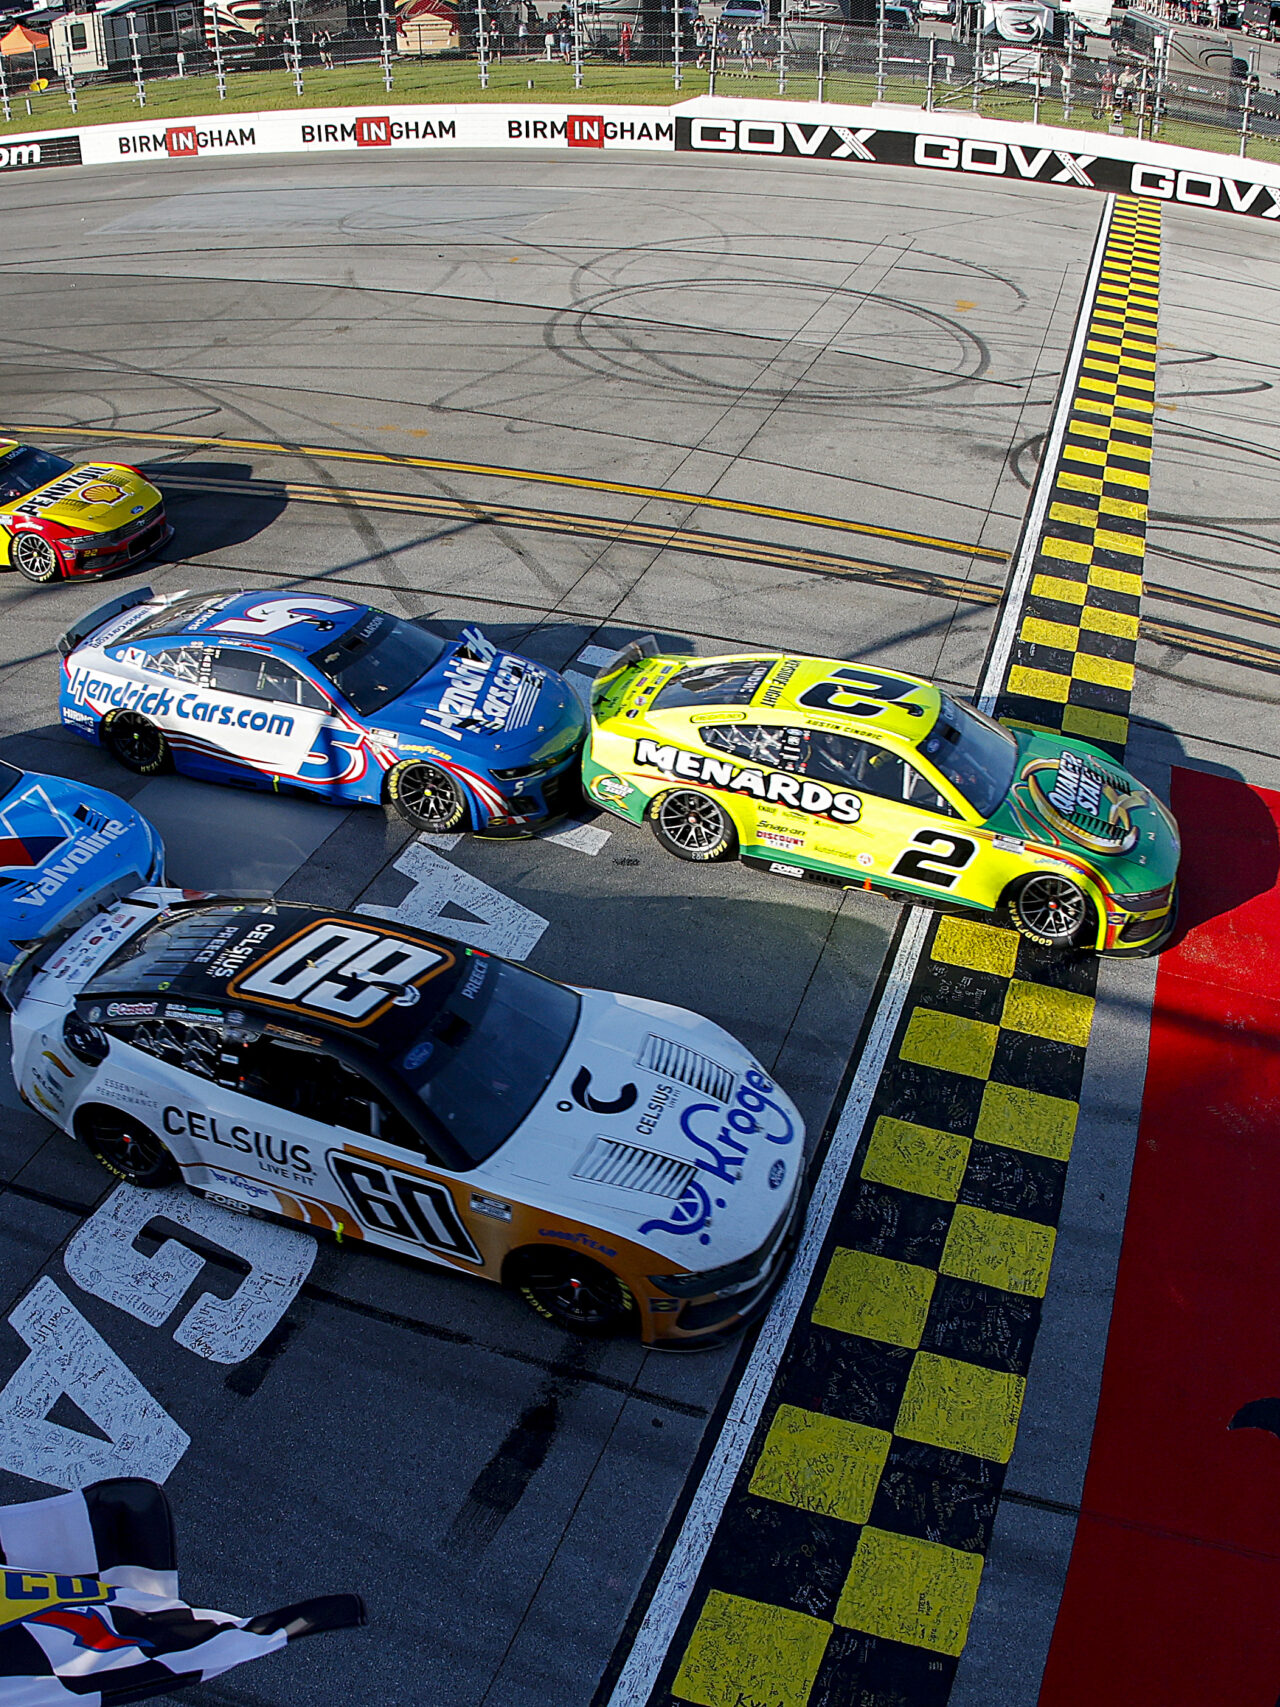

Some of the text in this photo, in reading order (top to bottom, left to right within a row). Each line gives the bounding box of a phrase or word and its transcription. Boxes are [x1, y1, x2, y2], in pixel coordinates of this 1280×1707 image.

[119, 125, 256, 157] BIRMINGHAM
[302, 116, 457, 147] BIRMINGHAM
[507, 114, 675, 149] BIRMINGHAM
[690, 118, 877, 162] GOVX
[914, 134, 1096, 187] GOVX
[13, 466, 117, 517] PENNZOIL
[360, 615, 385, 639] LARSON
[420, 624, 499, 740] Hendrick
[63, 708, 94, 728] HIRING
[806, 719, 883, 740] AUSTIN CINDRIC
[297, 725, 366, 782] 5
[634, 739, 862, 824] MENARDS
[1046, 750, 1084, 815] QUAKER
[1075, 763, 1106, 817] STATE
[756, 830, 805, 847] DISCOUNT
[757, 820, 806, 836] Snap-on
[12, 818, 130, 908] Valvoline
[771, 862, 804, 877] FORD
[890, 826, 977, 889] 2
[193, 926, 241, 964] PREECE
[215, 922, 275, 979] CELSIUS
[462, 960, 489, 1000] PREECE
[264, 1023, 324, 1046] PREECE
[96, 1086, 160, 1109] PERFORMANCE
[104, 1077, 150, 1099] ESSENTIAL
[636, 1083, 673, 1136] CELSIUS
[162, 1104, 317, 1175] CELSIUS
[228, 1175, 272, 1198] Kroger
[259, 1160, 316, 1188] LIVE FIT
[205, 1190, 250, 1211] FORD
[331, 1152, 472, 1254] 60
[539, 1228, 617, 1258] GOODYEAR
